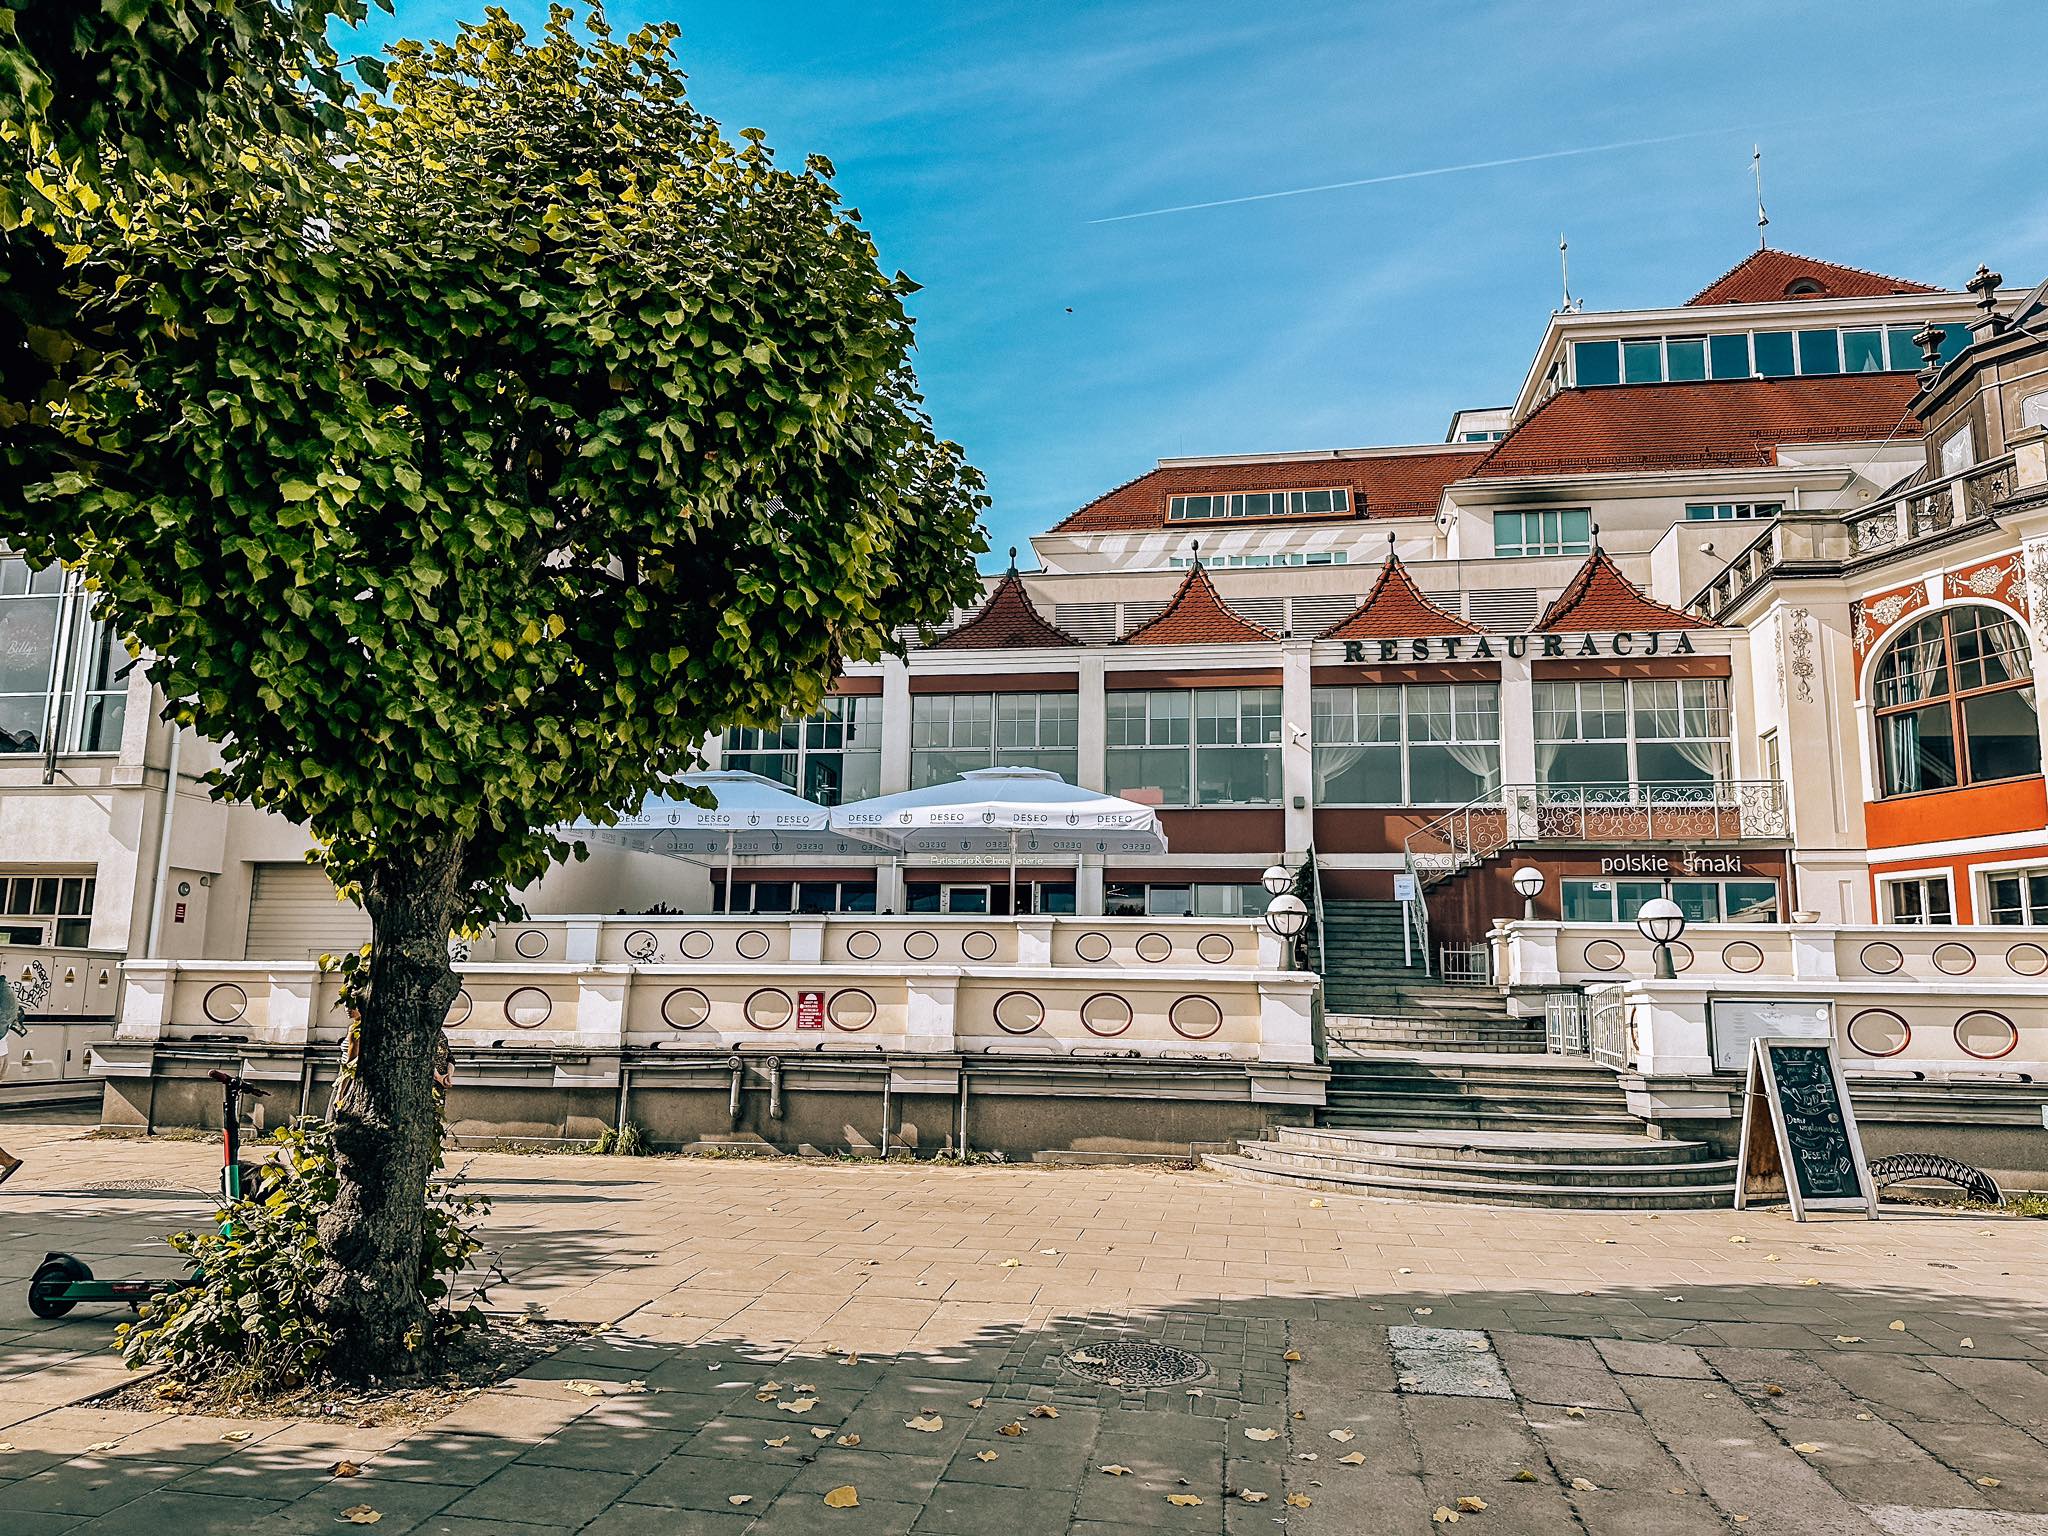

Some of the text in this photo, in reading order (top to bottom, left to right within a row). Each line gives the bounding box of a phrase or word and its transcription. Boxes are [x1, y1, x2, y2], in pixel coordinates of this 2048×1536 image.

[1343, 631, 1696, 663] RESTAURACJA
[618, 815, 651, 823] DESEO
[697, 814, 730, 823] DESEO
[776, 815, 810, 824] DESEO
[848, 814, 883, 822] DESEO
[930, 813, 965, 821] DESEO
[1013, 814, 1048, 822] DESEO
[1097, 815, 1133, 823] DESEO
[975, 855, 982, 865] &
[983, 855, 1043, 865] Choclaterie
[1601, 854, 1669, 874] polskie
